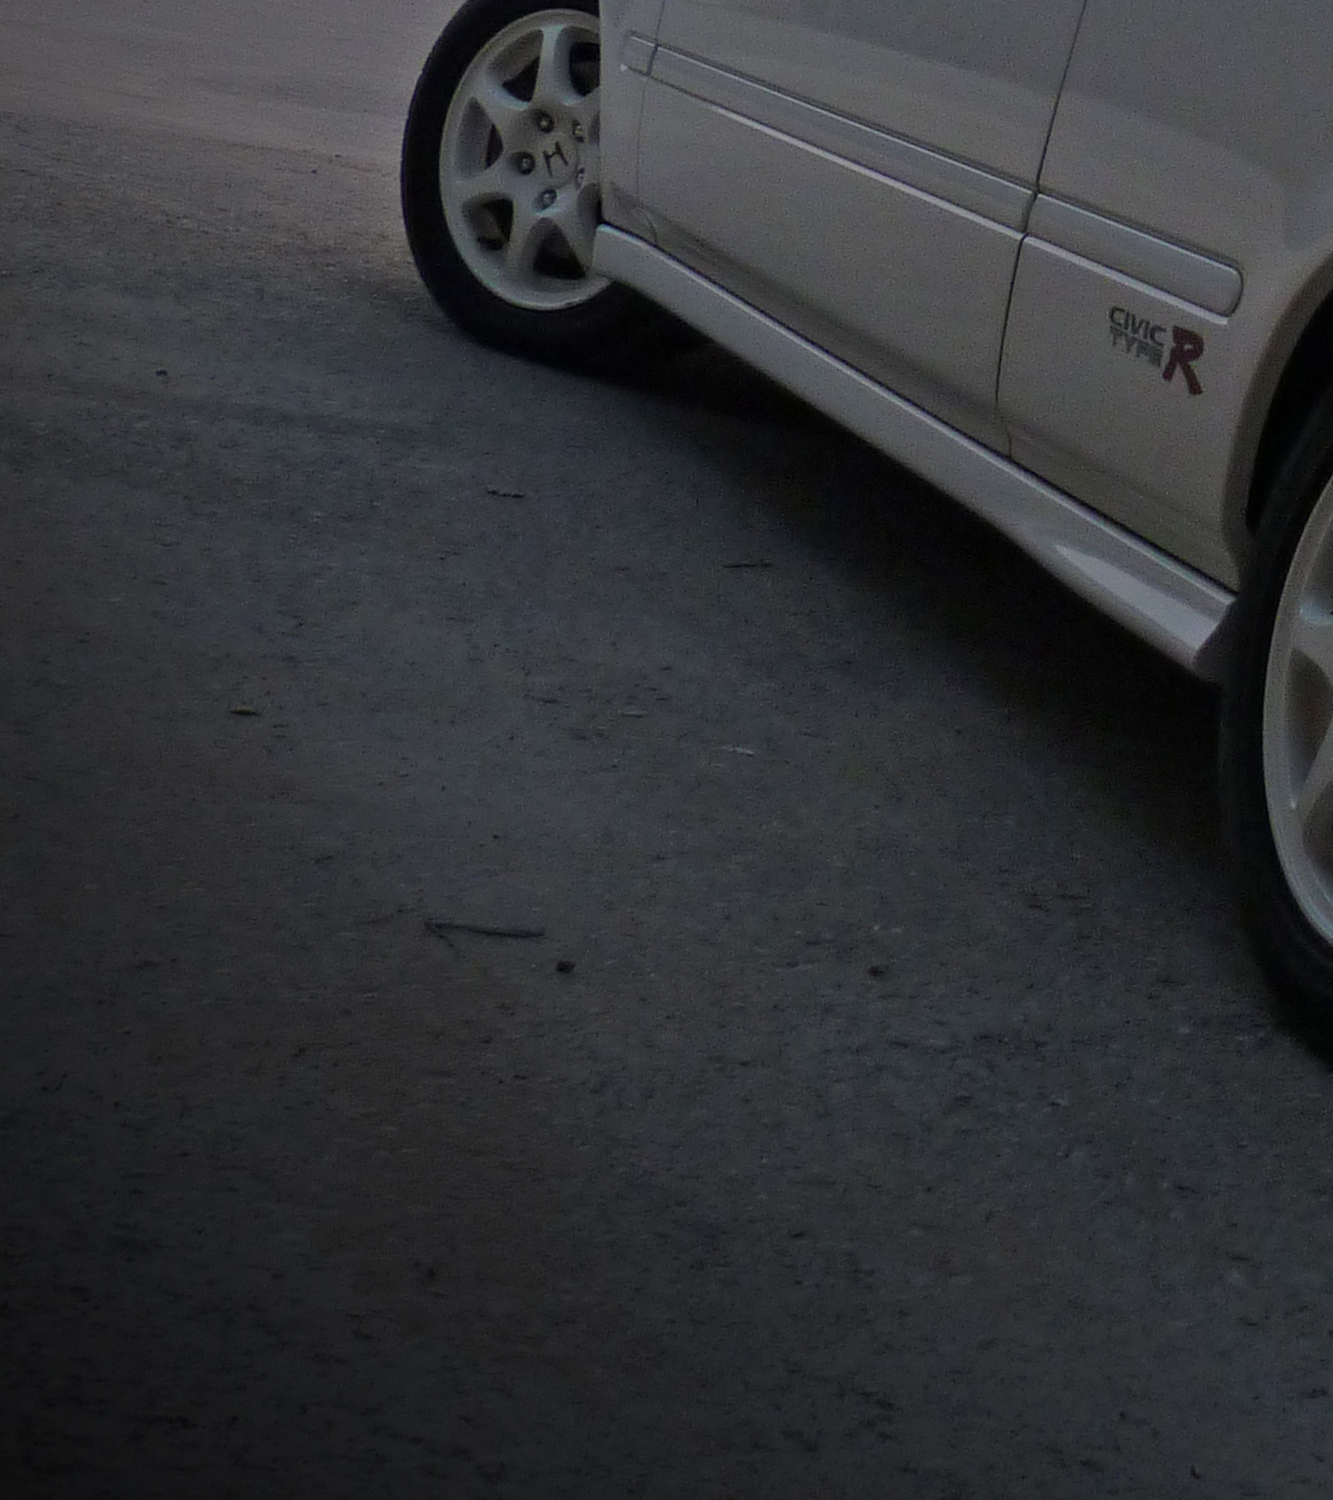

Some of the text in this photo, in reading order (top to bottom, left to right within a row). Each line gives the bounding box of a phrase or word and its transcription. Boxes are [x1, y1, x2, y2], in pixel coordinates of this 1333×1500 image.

[1109, 306, 1168, 347] CIVIC
[1110, 325, 1205, 395] TYPE R
